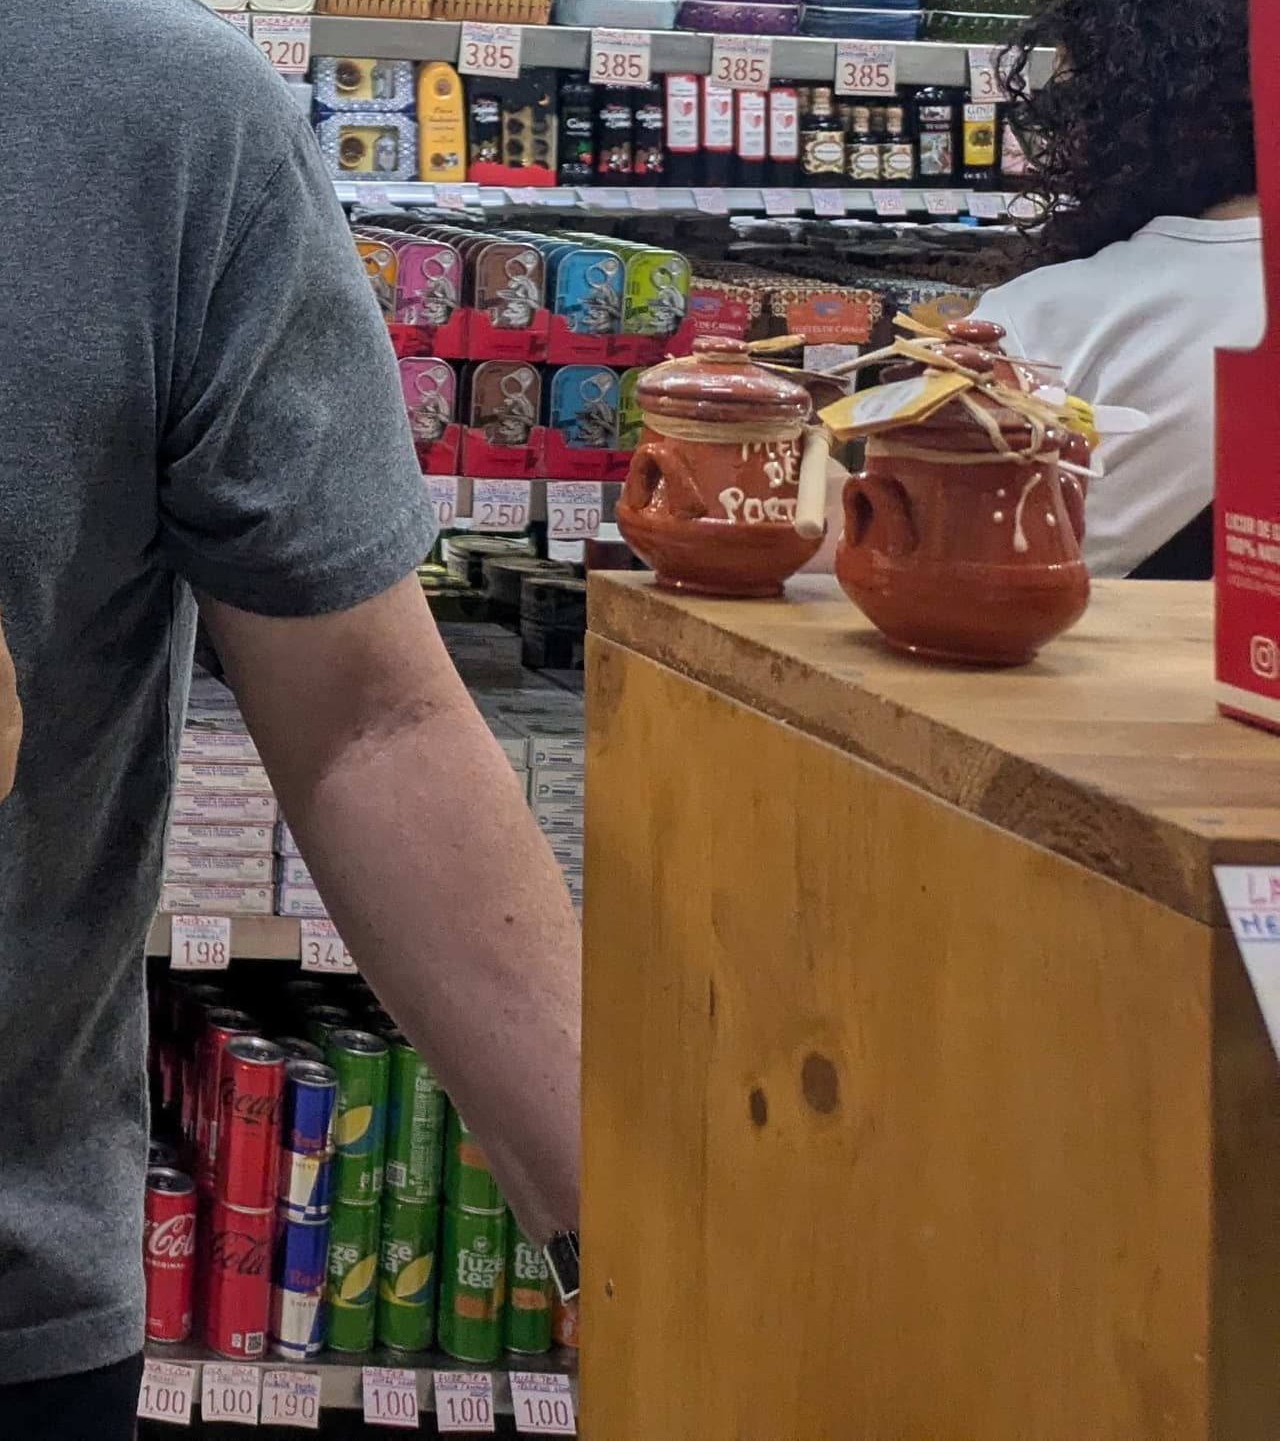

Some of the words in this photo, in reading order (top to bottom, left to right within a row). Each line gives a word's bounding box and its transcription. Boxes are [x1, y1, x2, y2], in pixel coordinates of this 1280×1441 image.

[464, 43, 514, 70] 3,85
[594, 51, 642, 78] 3,85
[717, 56, 765, 82] 3,85
[843, 61, 890, 88] 3,85
[718, 486, 798, 525] PORT
[458, 1248, 503, 1275] fuze
[514, 1242, 542, 1267] fu
[458, 1269, 494, 1288] tea
[207, 1388, 253, 1416] 1,00
[372, 1388, 417, 1417] 1,00
[447, 1396, 491, 1425] 1,00
[523, 1398, 570, 1428] 1,00
